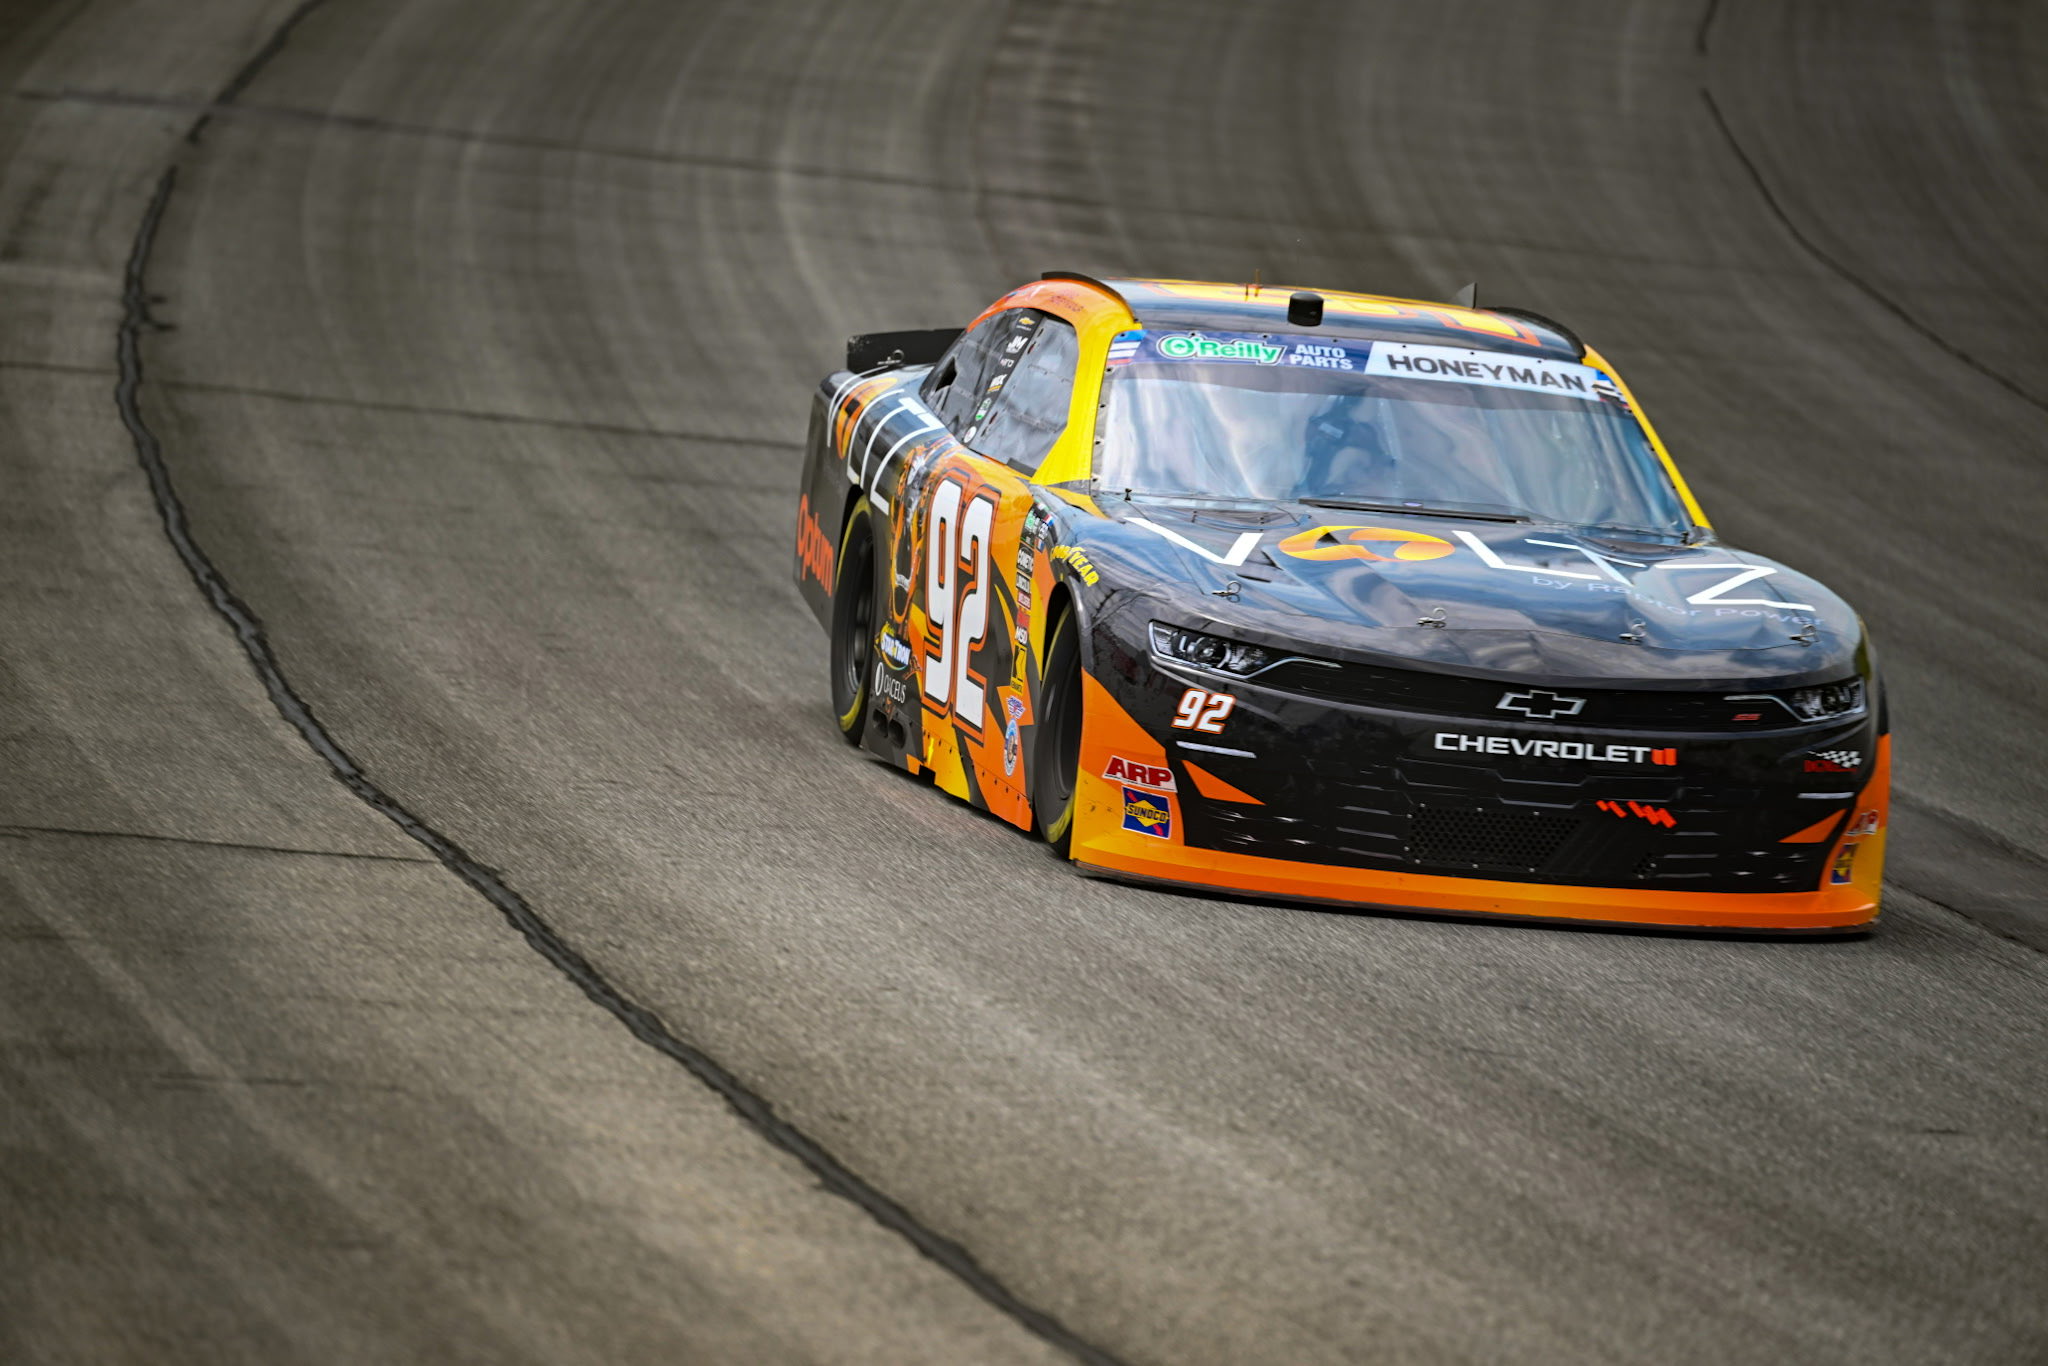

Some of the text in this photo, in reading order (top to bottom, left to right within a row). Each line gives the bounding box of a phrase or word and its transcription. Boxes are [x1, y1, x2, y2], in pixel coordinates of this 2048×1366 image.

[1163, 336, 1281, 363] O'Reilly
[1289, 354, 1354, 370] PARTS
[1294, 343, 1347, 358] AUTO
[1386, 354, 1588, 393] HONEYMAN
[922, 473, 999, 740] 92
[1531, 576, 1573, 591] by
[1714, 607, 1825, 626] Power
[1173, 688, 1236, 735] 92
[1434, 732, 1652, 764] CHEVROLET
[1105, 756, 1173, 787] ARP
[1126, 803, 1169, 823] SUNOCO
